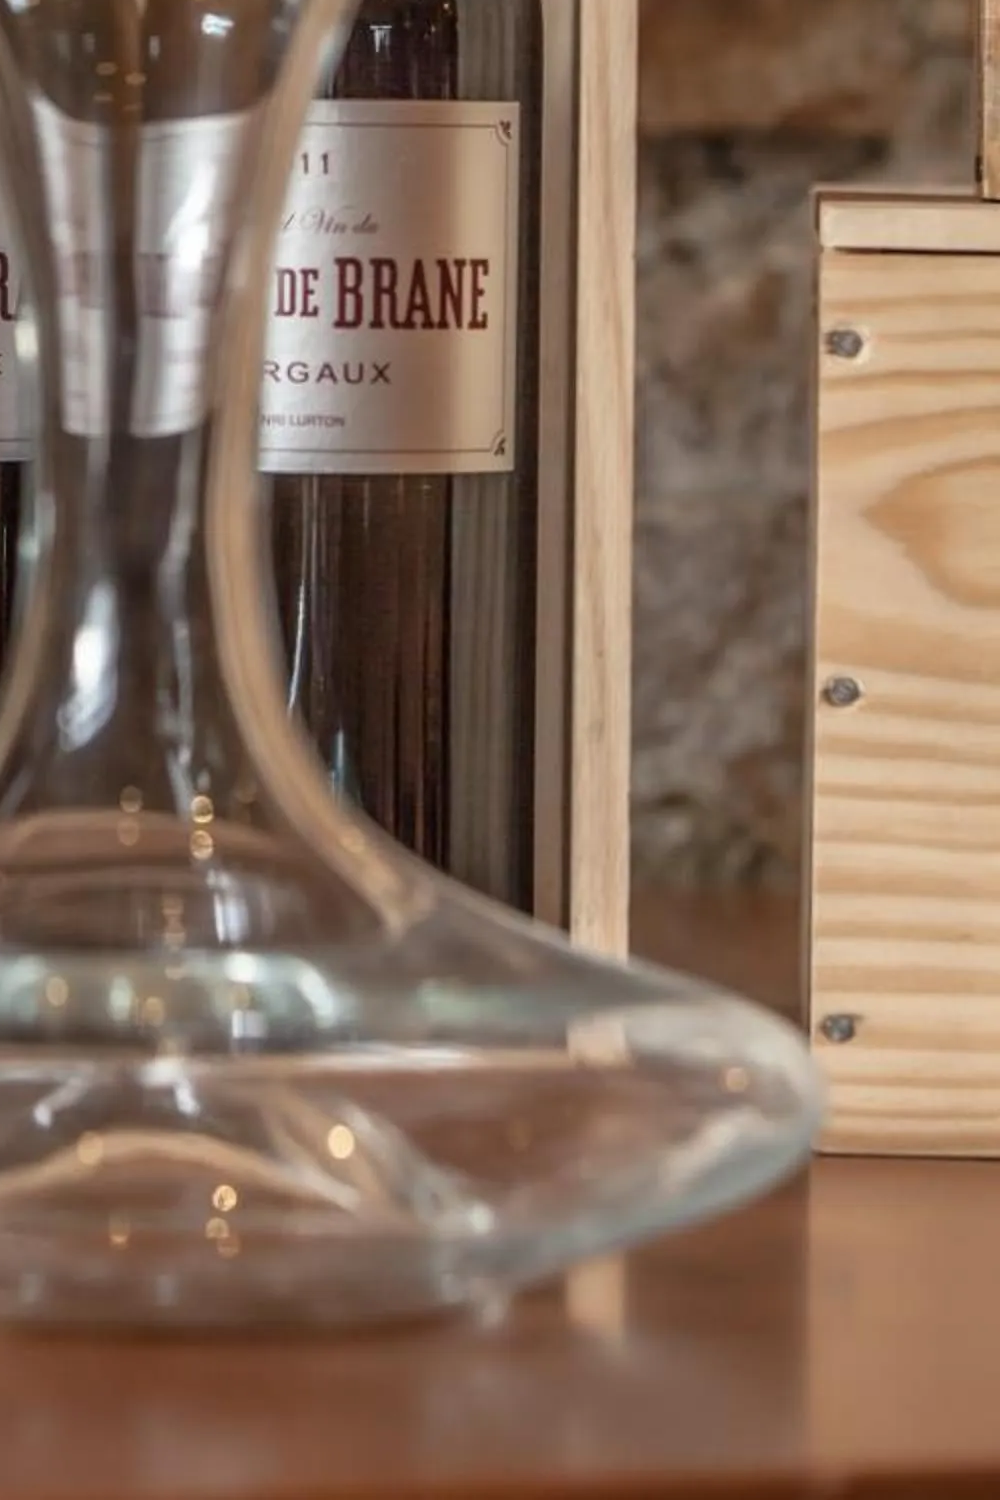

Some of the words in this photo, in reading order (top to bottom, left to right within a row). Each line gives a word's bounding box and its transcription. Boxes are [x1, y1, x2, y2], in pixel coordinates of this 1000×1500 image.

[302, 152, 329, 175] 11
[274, 267, 319, 317] DE
[333, 256, 490, 330] BRANE
[263, 360, 392, 385] RGAUX
[289, 413, 345, 427] LURTON
